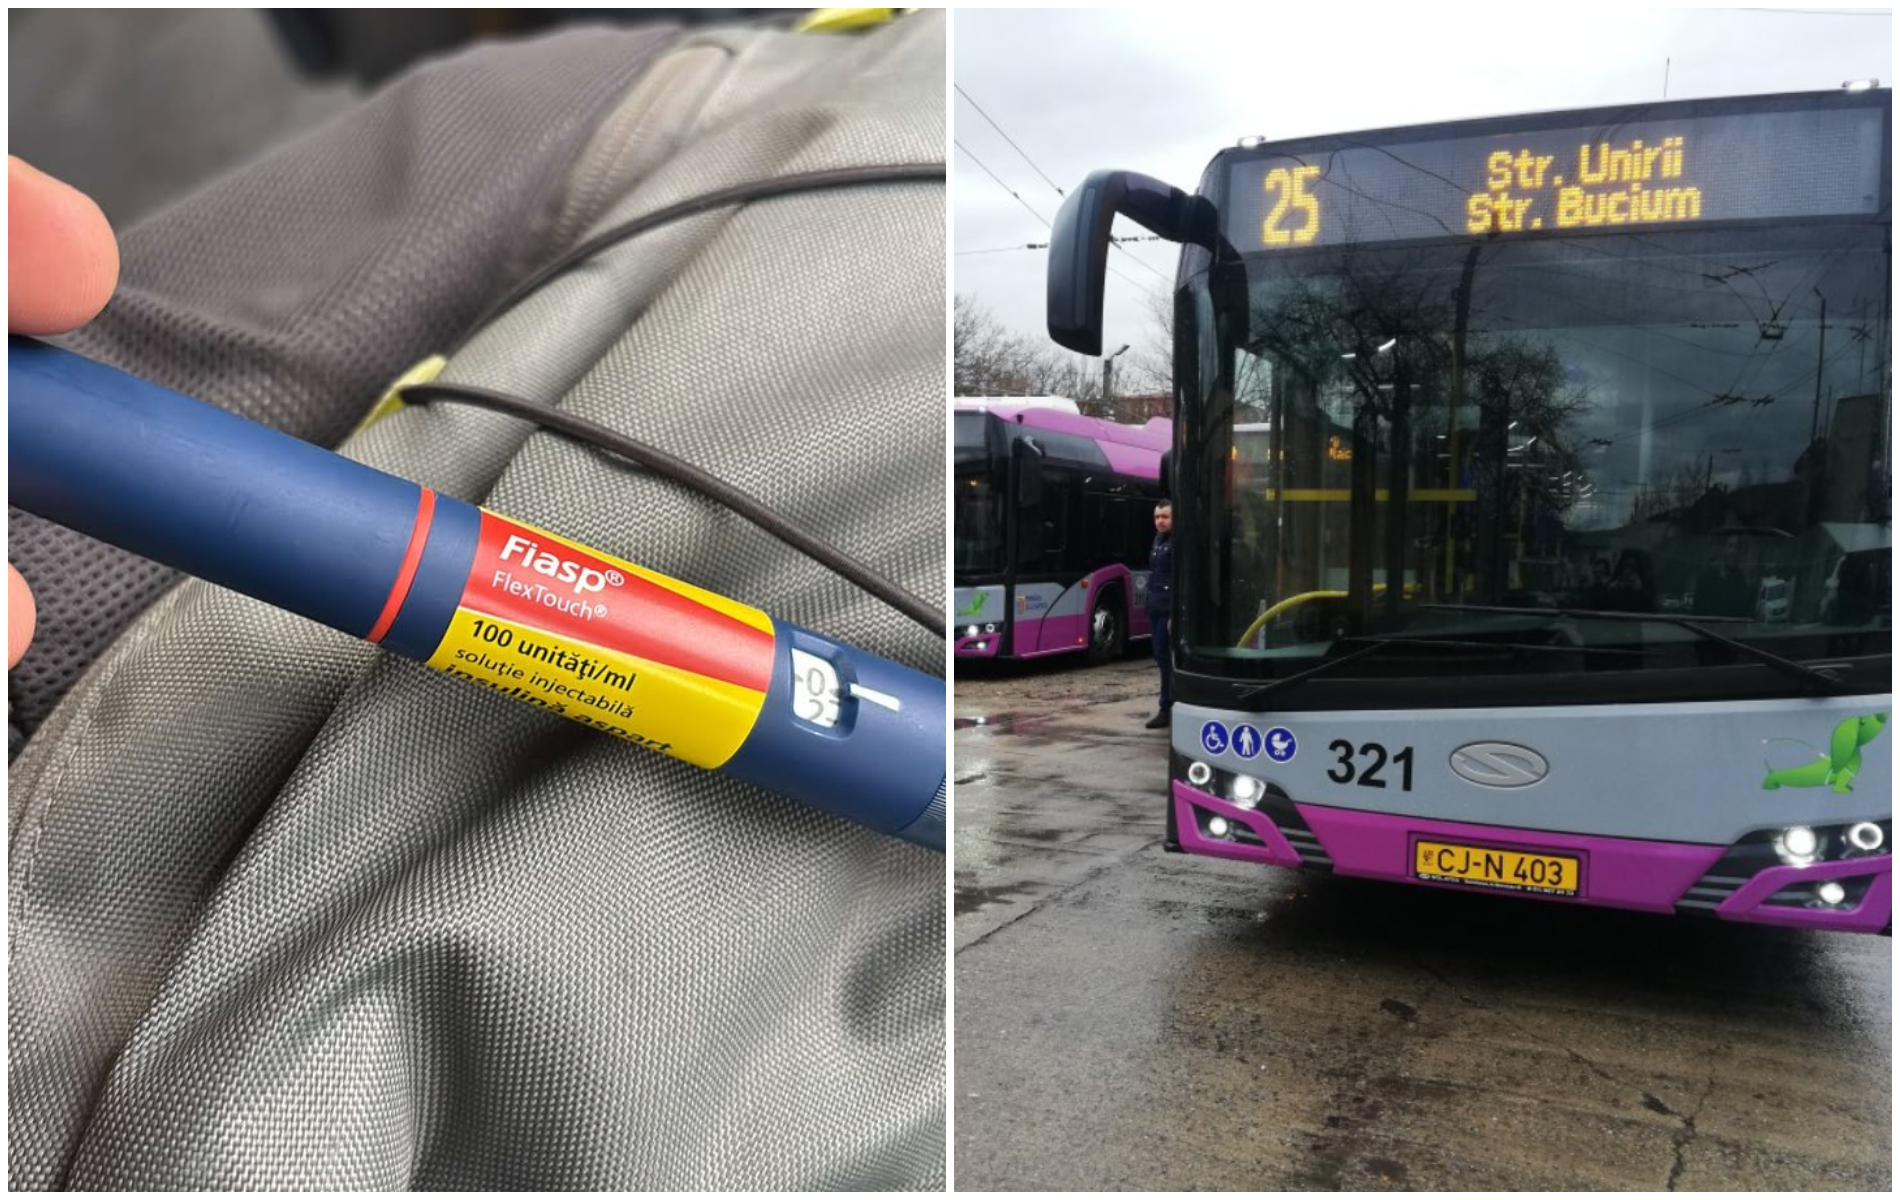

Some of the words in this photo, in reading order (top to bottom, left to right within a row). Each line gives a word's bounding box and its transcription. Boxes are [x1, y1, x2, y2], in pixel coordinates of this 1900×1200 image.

[1487, 149, 1563, 189] Str.
[1579, 137, 1685, 184] Unirii
[1262, 165, 1321, 245] 25
[1467, 192, 1543, 233] Str.
[1556, 183, 1702, 227] Bucium
[473, 620, 513, 647] 100
[529, 672, 635, 719] injectabilă
[806, 667, 826, 696] 0
[573, 713, 673, 752] aspart
[1327, 739, 1414, 792] 321
[1437, 848, 1504, 879] CJ-N
[1513, 857, 1563, 886] 403
